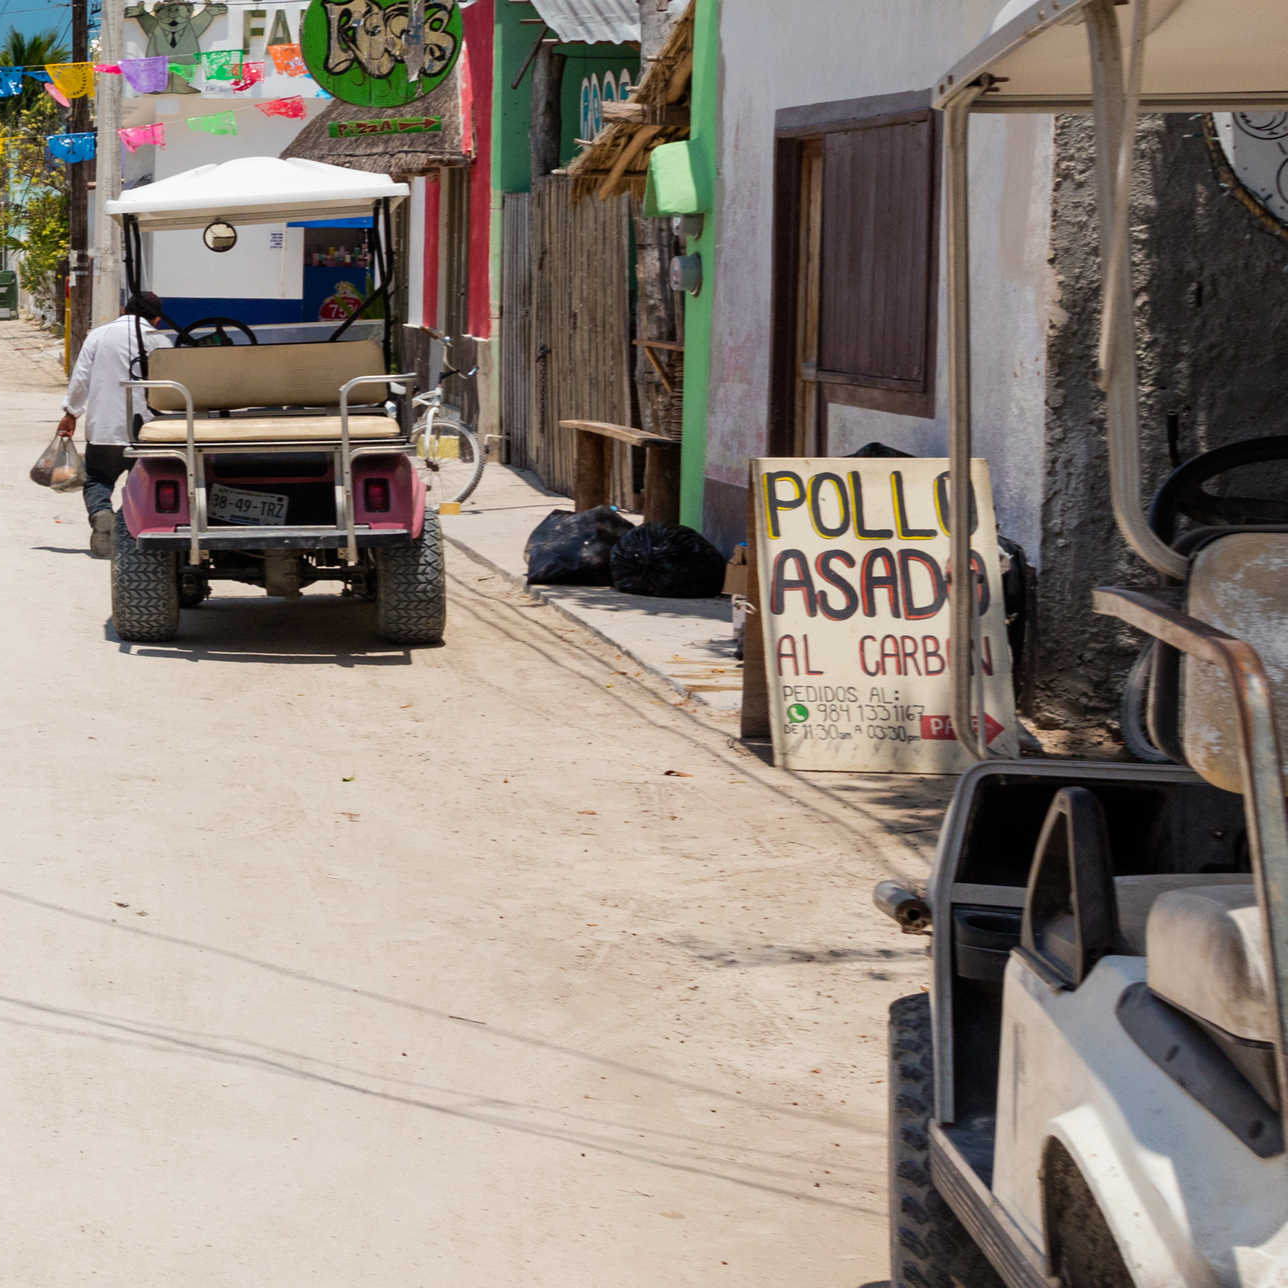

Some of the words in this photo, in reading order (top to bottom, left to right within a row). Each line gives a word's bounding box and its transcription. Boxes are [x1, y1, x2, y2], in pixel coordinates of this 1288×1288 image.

[242, 9, 306, 56] FA
[211, 493, 285, 519] 38-49-TRZ
[762, 470, 978, 540] POLLO
[777, 634, 824, 677] AL
[859, 634, 994, 677] CARBN
[782, 685, 858, 703] PEDIDOS
[870, 686, 900, 704] AL:
[817, 703, 852, 723] 984
[784, 724, 798, 735] DE
[854, 724, 863, 734] A
